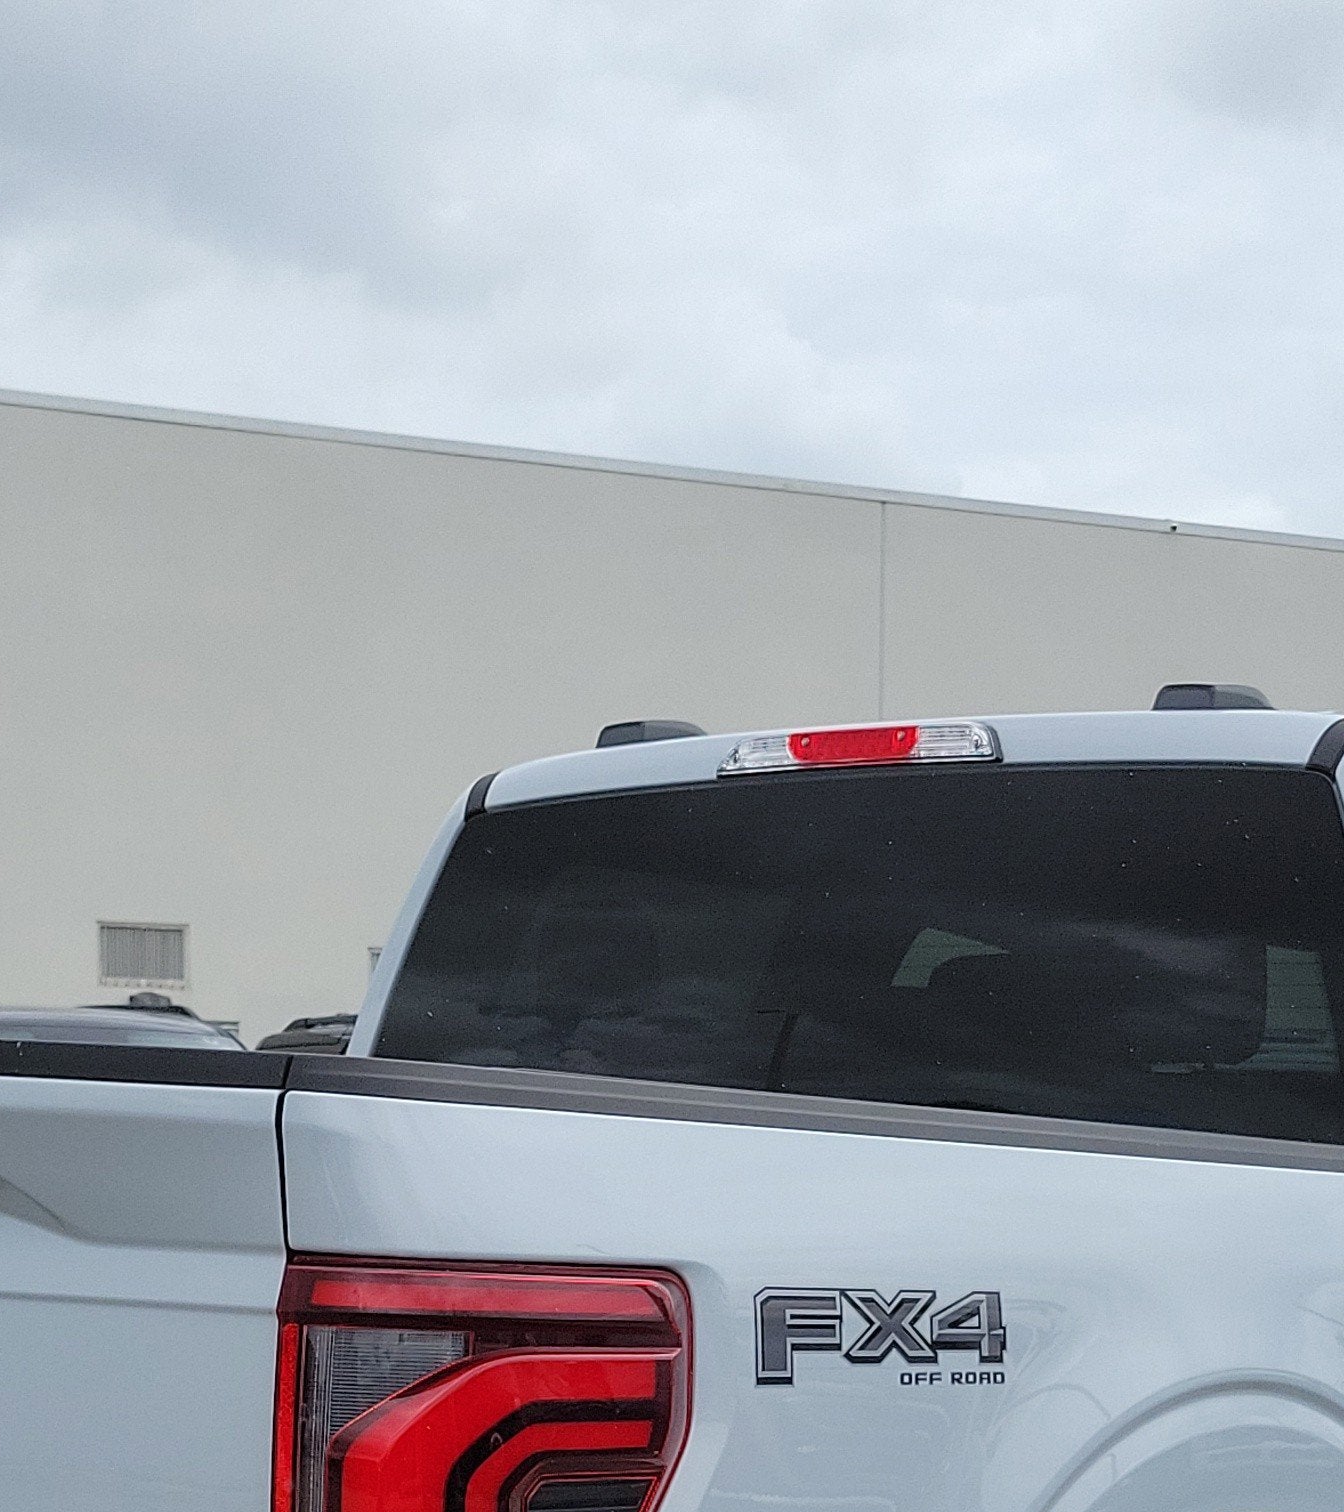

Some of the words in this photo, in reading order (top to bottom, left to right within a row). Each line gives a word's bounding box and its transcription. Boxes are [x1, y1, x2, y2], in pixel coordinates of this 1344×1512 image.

[754, 1286, 1006, 1386] FX4
[900, 1372, 942, 1386] OFF
[951, 1371, 1006, 1385] ROAD
